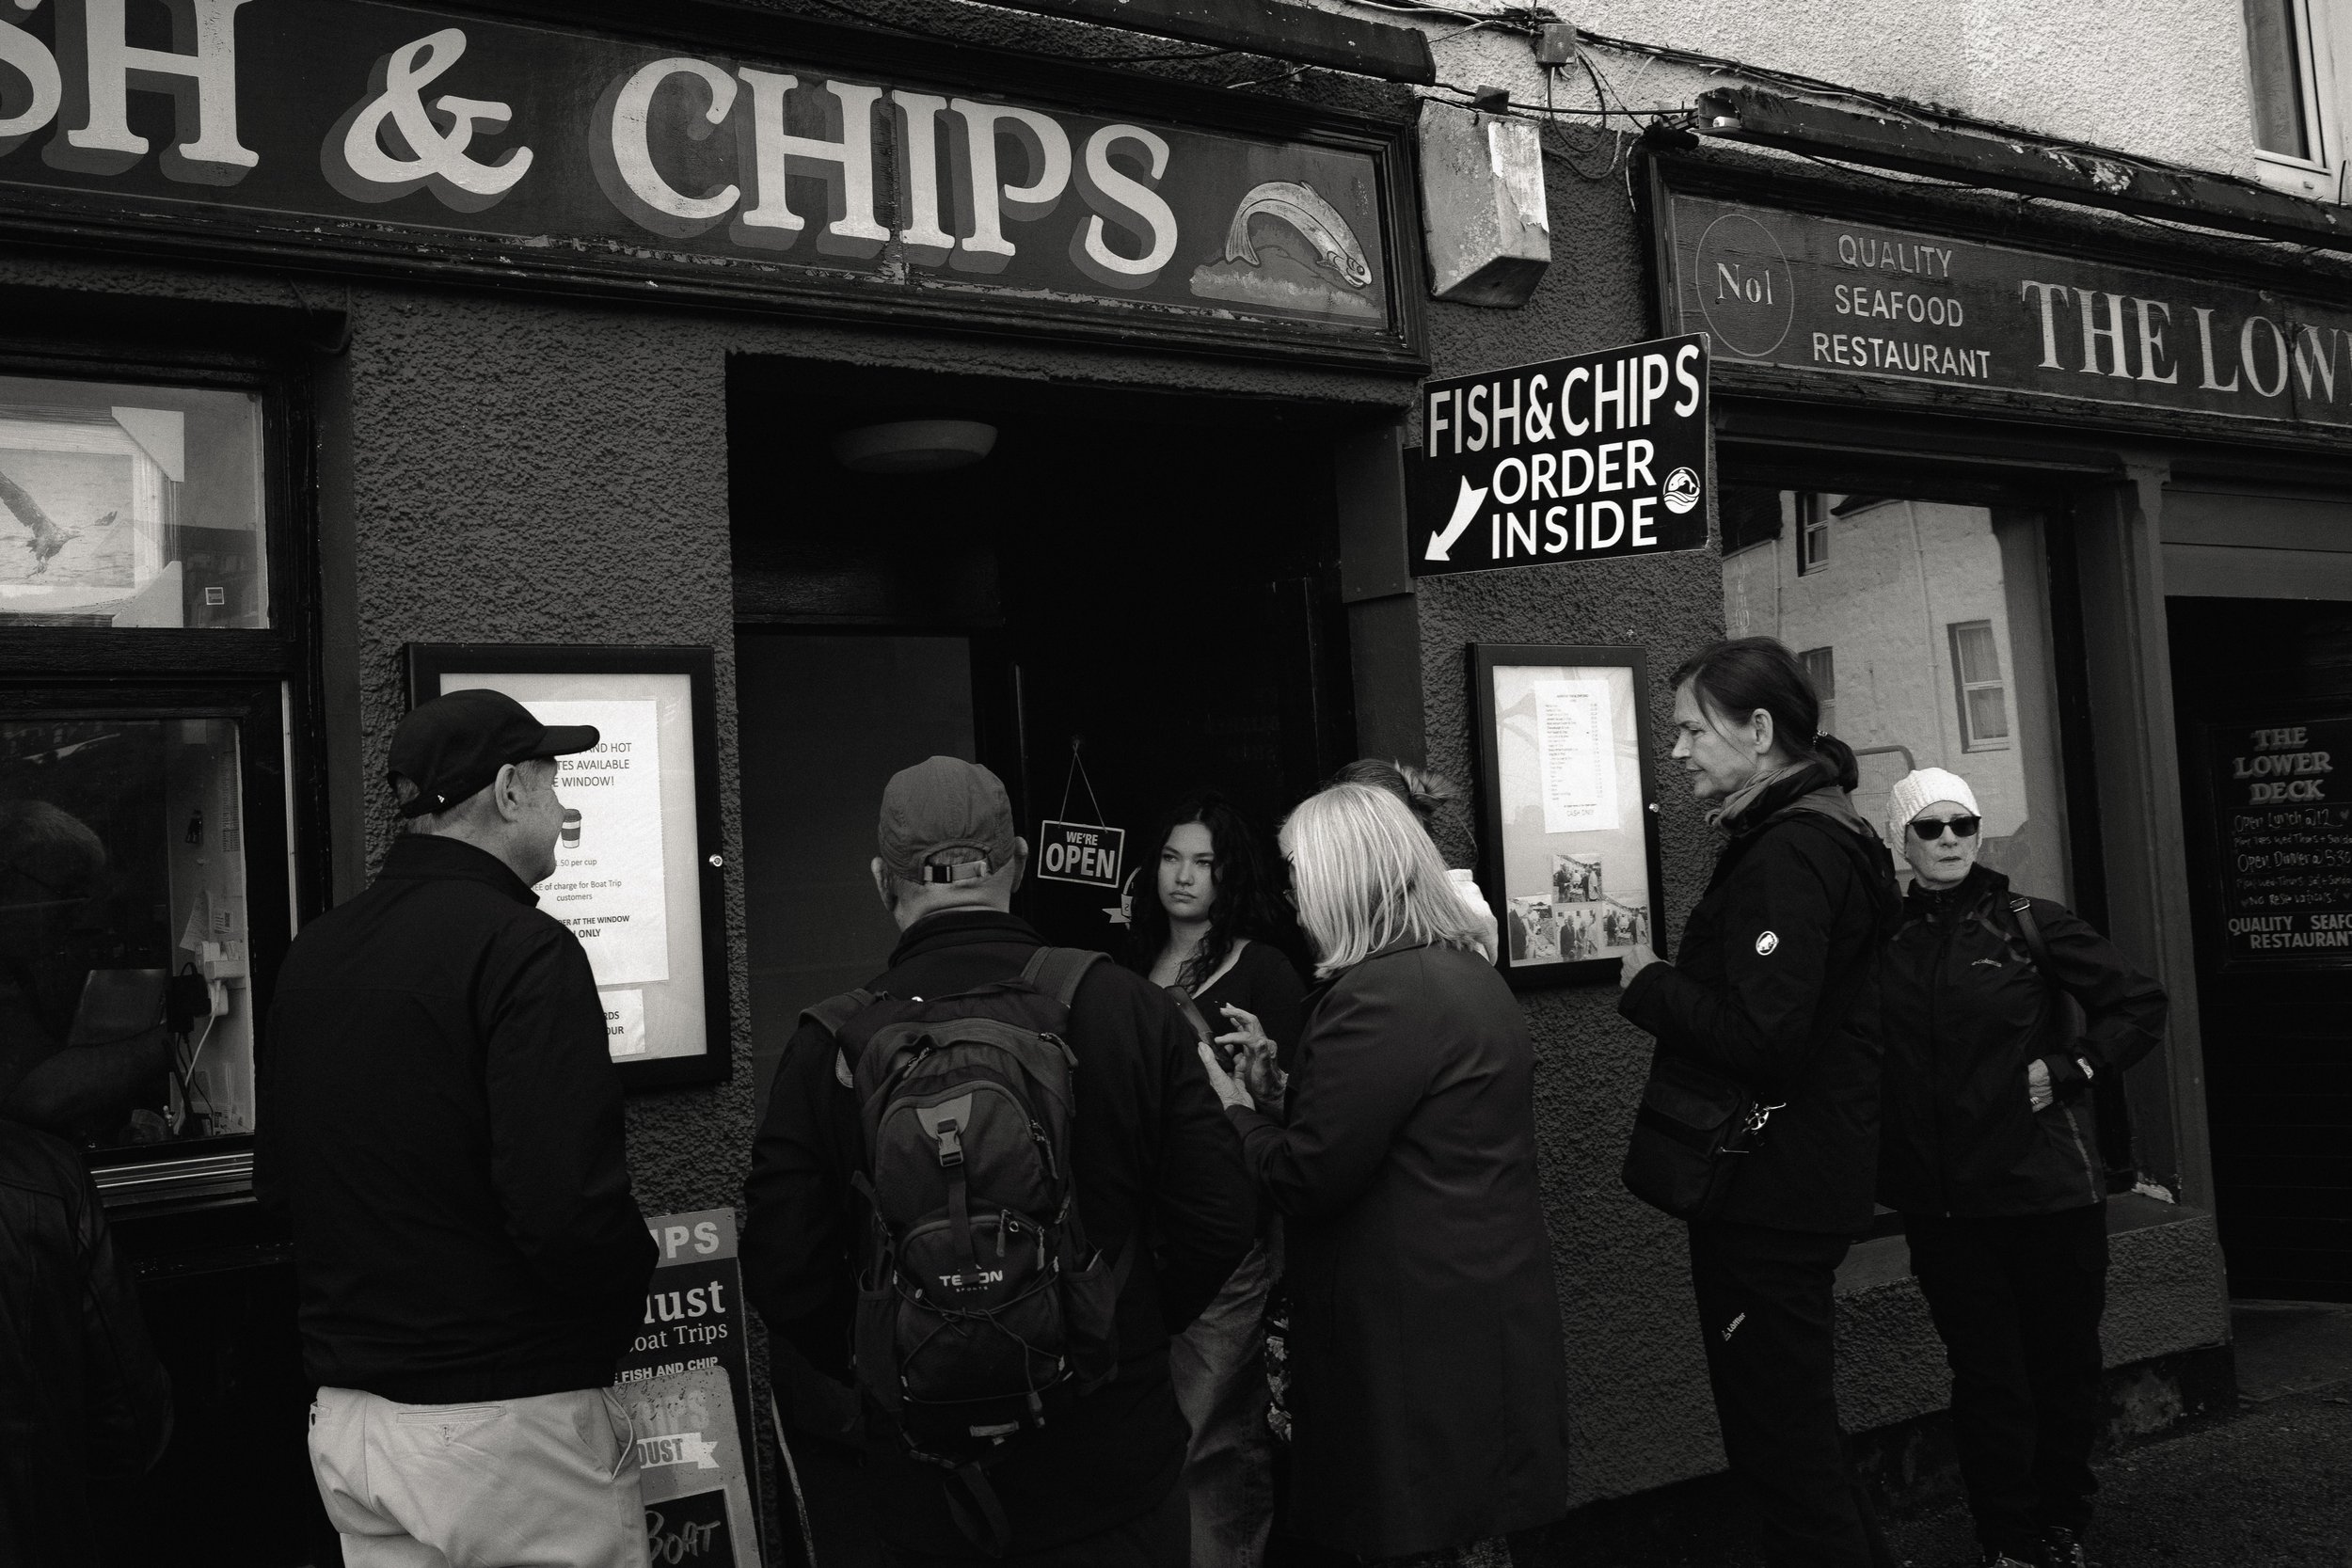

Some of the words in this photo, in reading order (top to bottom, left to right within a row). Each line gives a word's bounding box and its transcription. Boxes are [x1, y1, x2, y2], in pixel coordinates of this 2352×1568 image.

[344, 27, 533, 196] &
[612, 57, 1177, 276] CHIPS
[1837, 233, 1953, 278] QUALITY
[1835, 284, 1964, 328] SEAFOOD
[1812, 331, 1991, 379] RESTAURANT
[2021, 279, 2179, 386] THE
[2192, 304, 2352, 405] LOW
[1493, 438, 1658, 505] ORDER
[1491, 496, 1658, 560] INSIDE
[611, 742, 632, 752] HOT
[2249, 726, 2309, 752] THE
[577, 759, 630, 770] AVAILABLE
[2232, 752, 2333, 780] LOWER
[562, 776, 614, 787] WINDOW!
[2249, 779, 2326, 806] DECK
[1066, 831, 1099, 847] WE'RE
[1045, 842, 1116, 879] OPEN
[553, 881, 578, 891] charge
[579, 880, 589, 889] for
[608, 879, 622, 888] Trip
[556, 894, 593, 902] customers
[596, 915, 630, 924] WINDOW
[2228, 916, 2294, 936] QUALITY
[578, 928, 601, 938] ONLY
[629, 1329, 668, 1353] oat
[673, 1323, 728, 1345] Trips
[621, 1367, 652, 1383] FISH
[656, 1362, 684, 1377] AND
